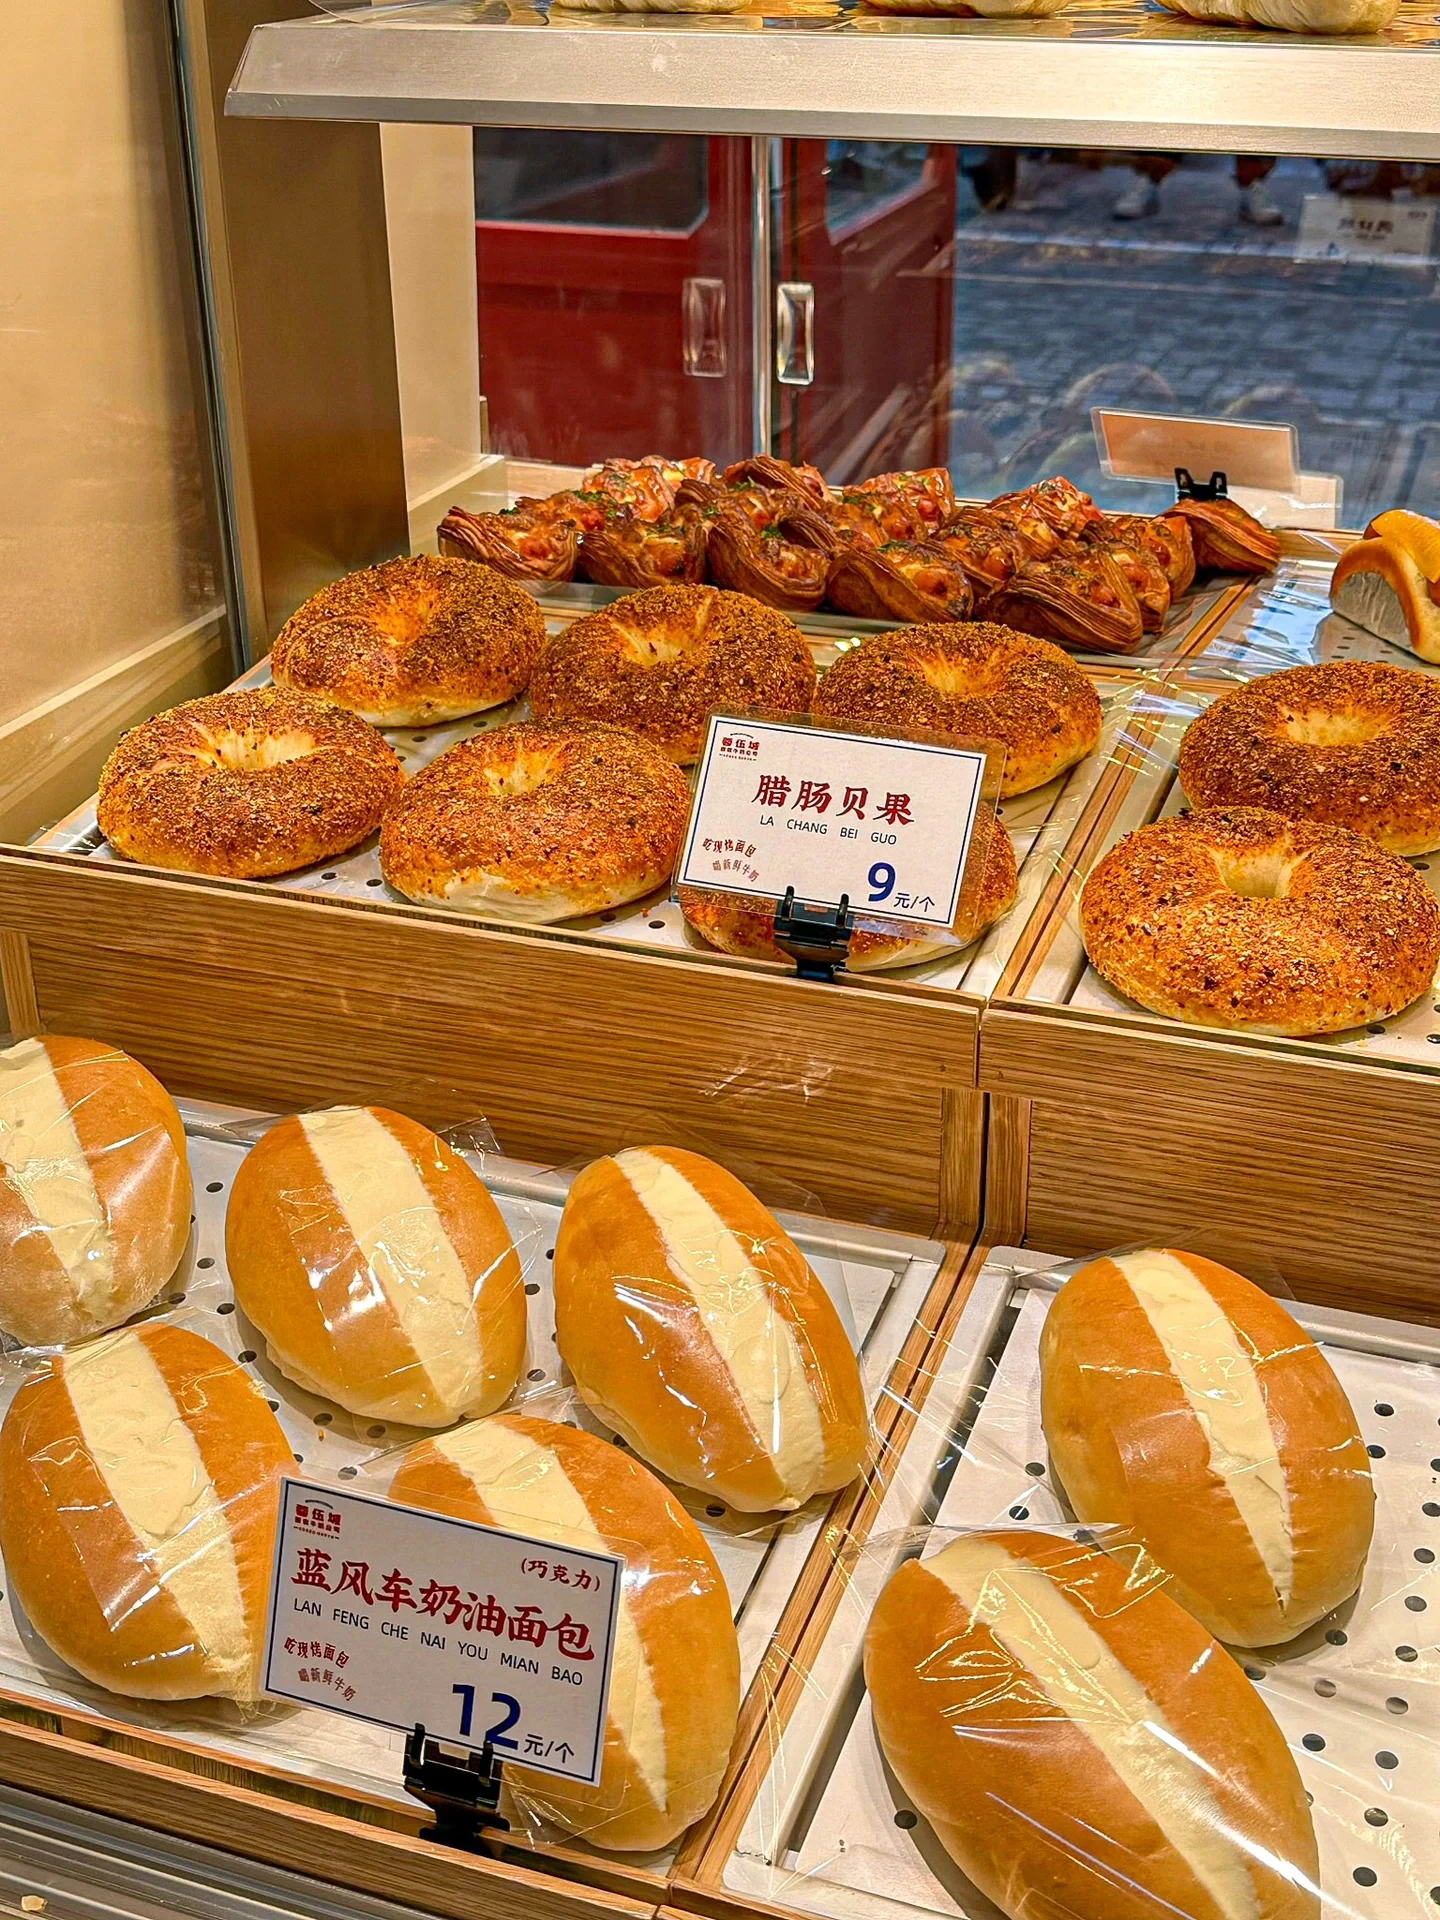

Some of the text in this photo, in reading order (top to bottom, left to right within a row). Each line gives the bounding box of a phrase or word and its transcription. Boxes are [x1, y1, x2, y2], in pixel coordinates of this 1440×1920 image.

[751, 775, 914, 825] 腊肠贝果
[760, 815, 897, 845] LA CHANG BEI GUO
[702, 838, 757, 858] 吃现烤面包
[521, 1558, 600, 1591] (巧克力)
[291, 1548, 595, 1660] 蓝风车奶油面包
[284, 1637, 349, 1668] 吃现烤面包
[294, 1598, 583, 1685] LAN FENG CHE NAI YOU MIAN BAO
